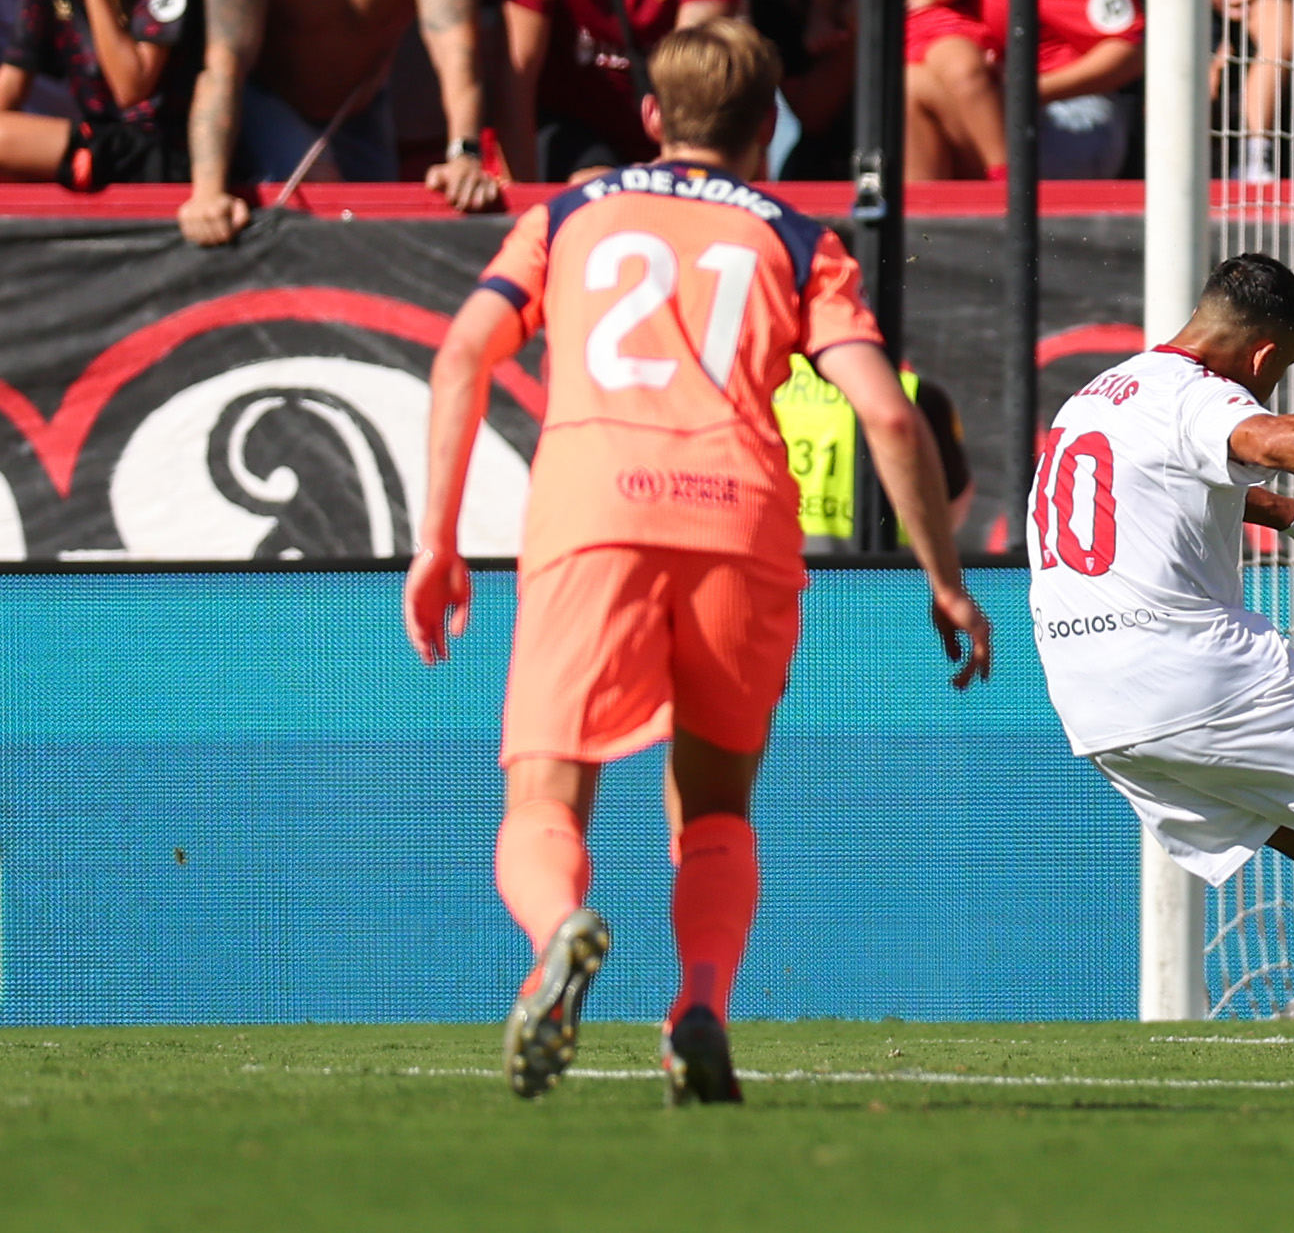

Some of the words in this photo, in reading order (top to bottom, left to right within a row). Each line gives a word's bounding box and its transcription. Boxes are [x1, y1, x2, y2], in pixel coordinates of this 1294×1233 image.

[621, 167, 674, 195] DE
[675, 178, 783, 220] JONG
[585, 232, 757, 390] 21
[793, 439, 839, 477] 31
[1033, 427, 1117, 577] 10
